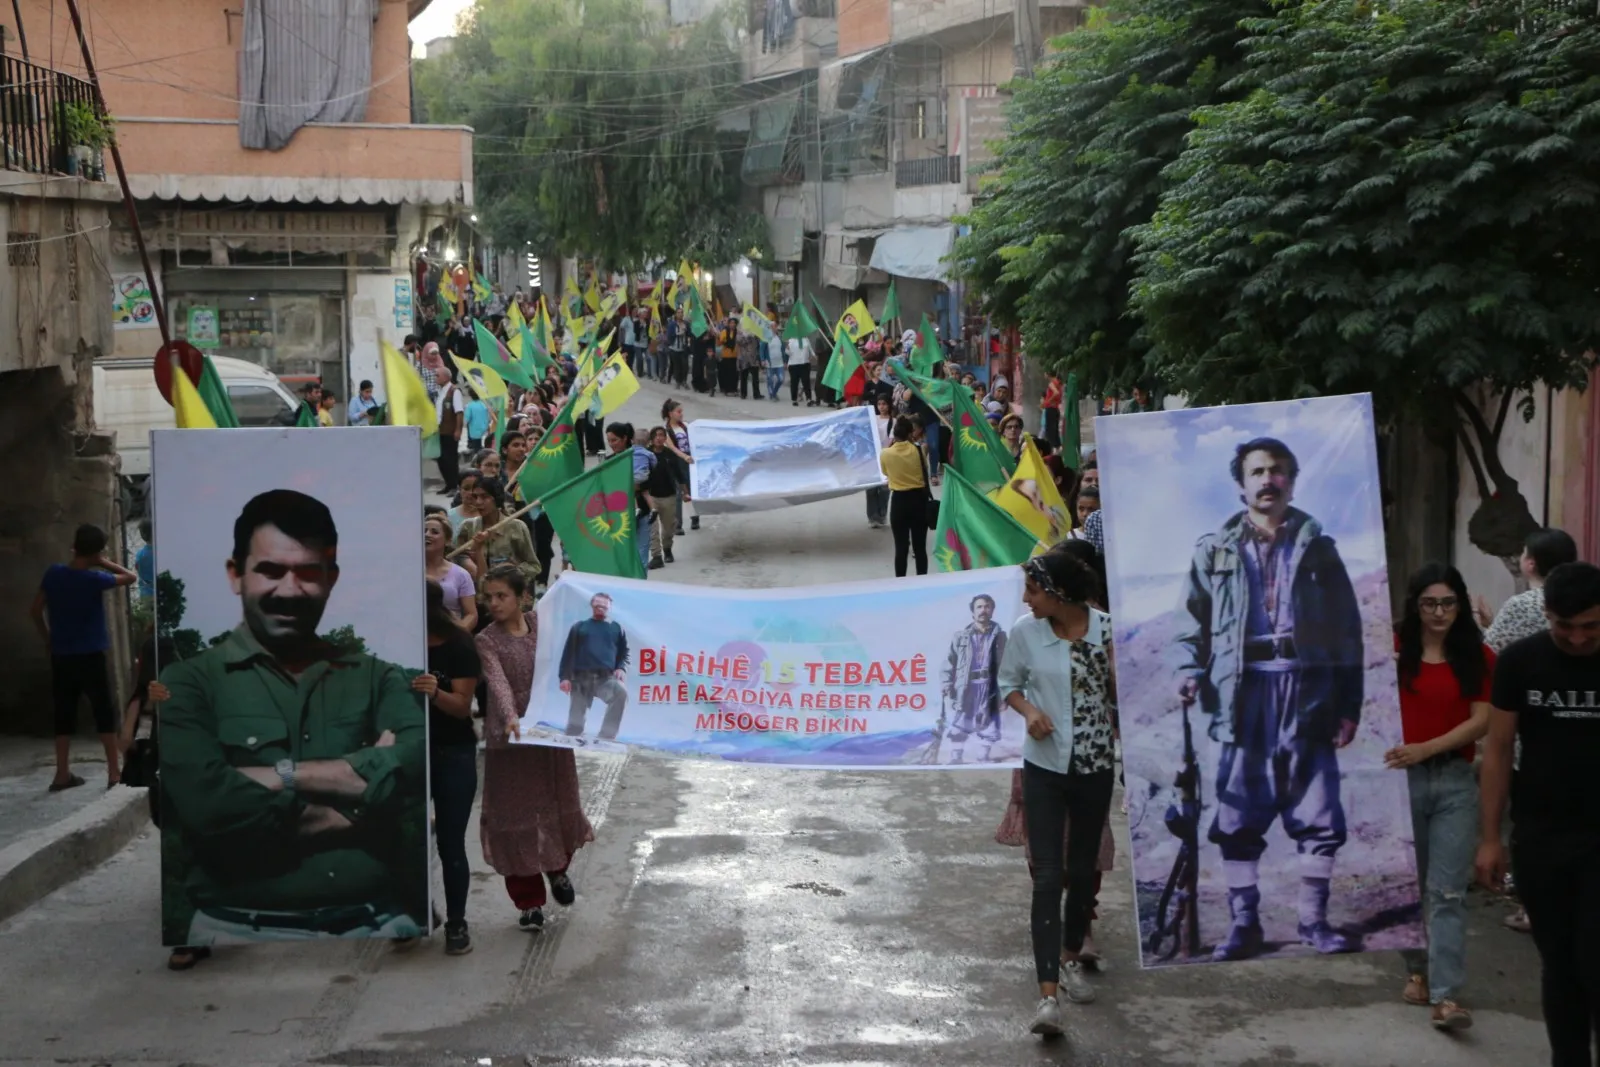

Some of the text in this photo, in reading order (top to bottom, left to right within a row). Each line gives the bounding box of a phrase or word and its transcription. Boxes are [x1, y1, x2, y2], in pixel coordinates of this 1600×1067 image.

[638, 646, 928, 685] Bİ RİHÊ 15 TEBAXÊ
[638, 680, 927, 711] EM Ê AZADİYA RÊBER APO
[695, 709, 868, 733] MİSOGER BİKİN
